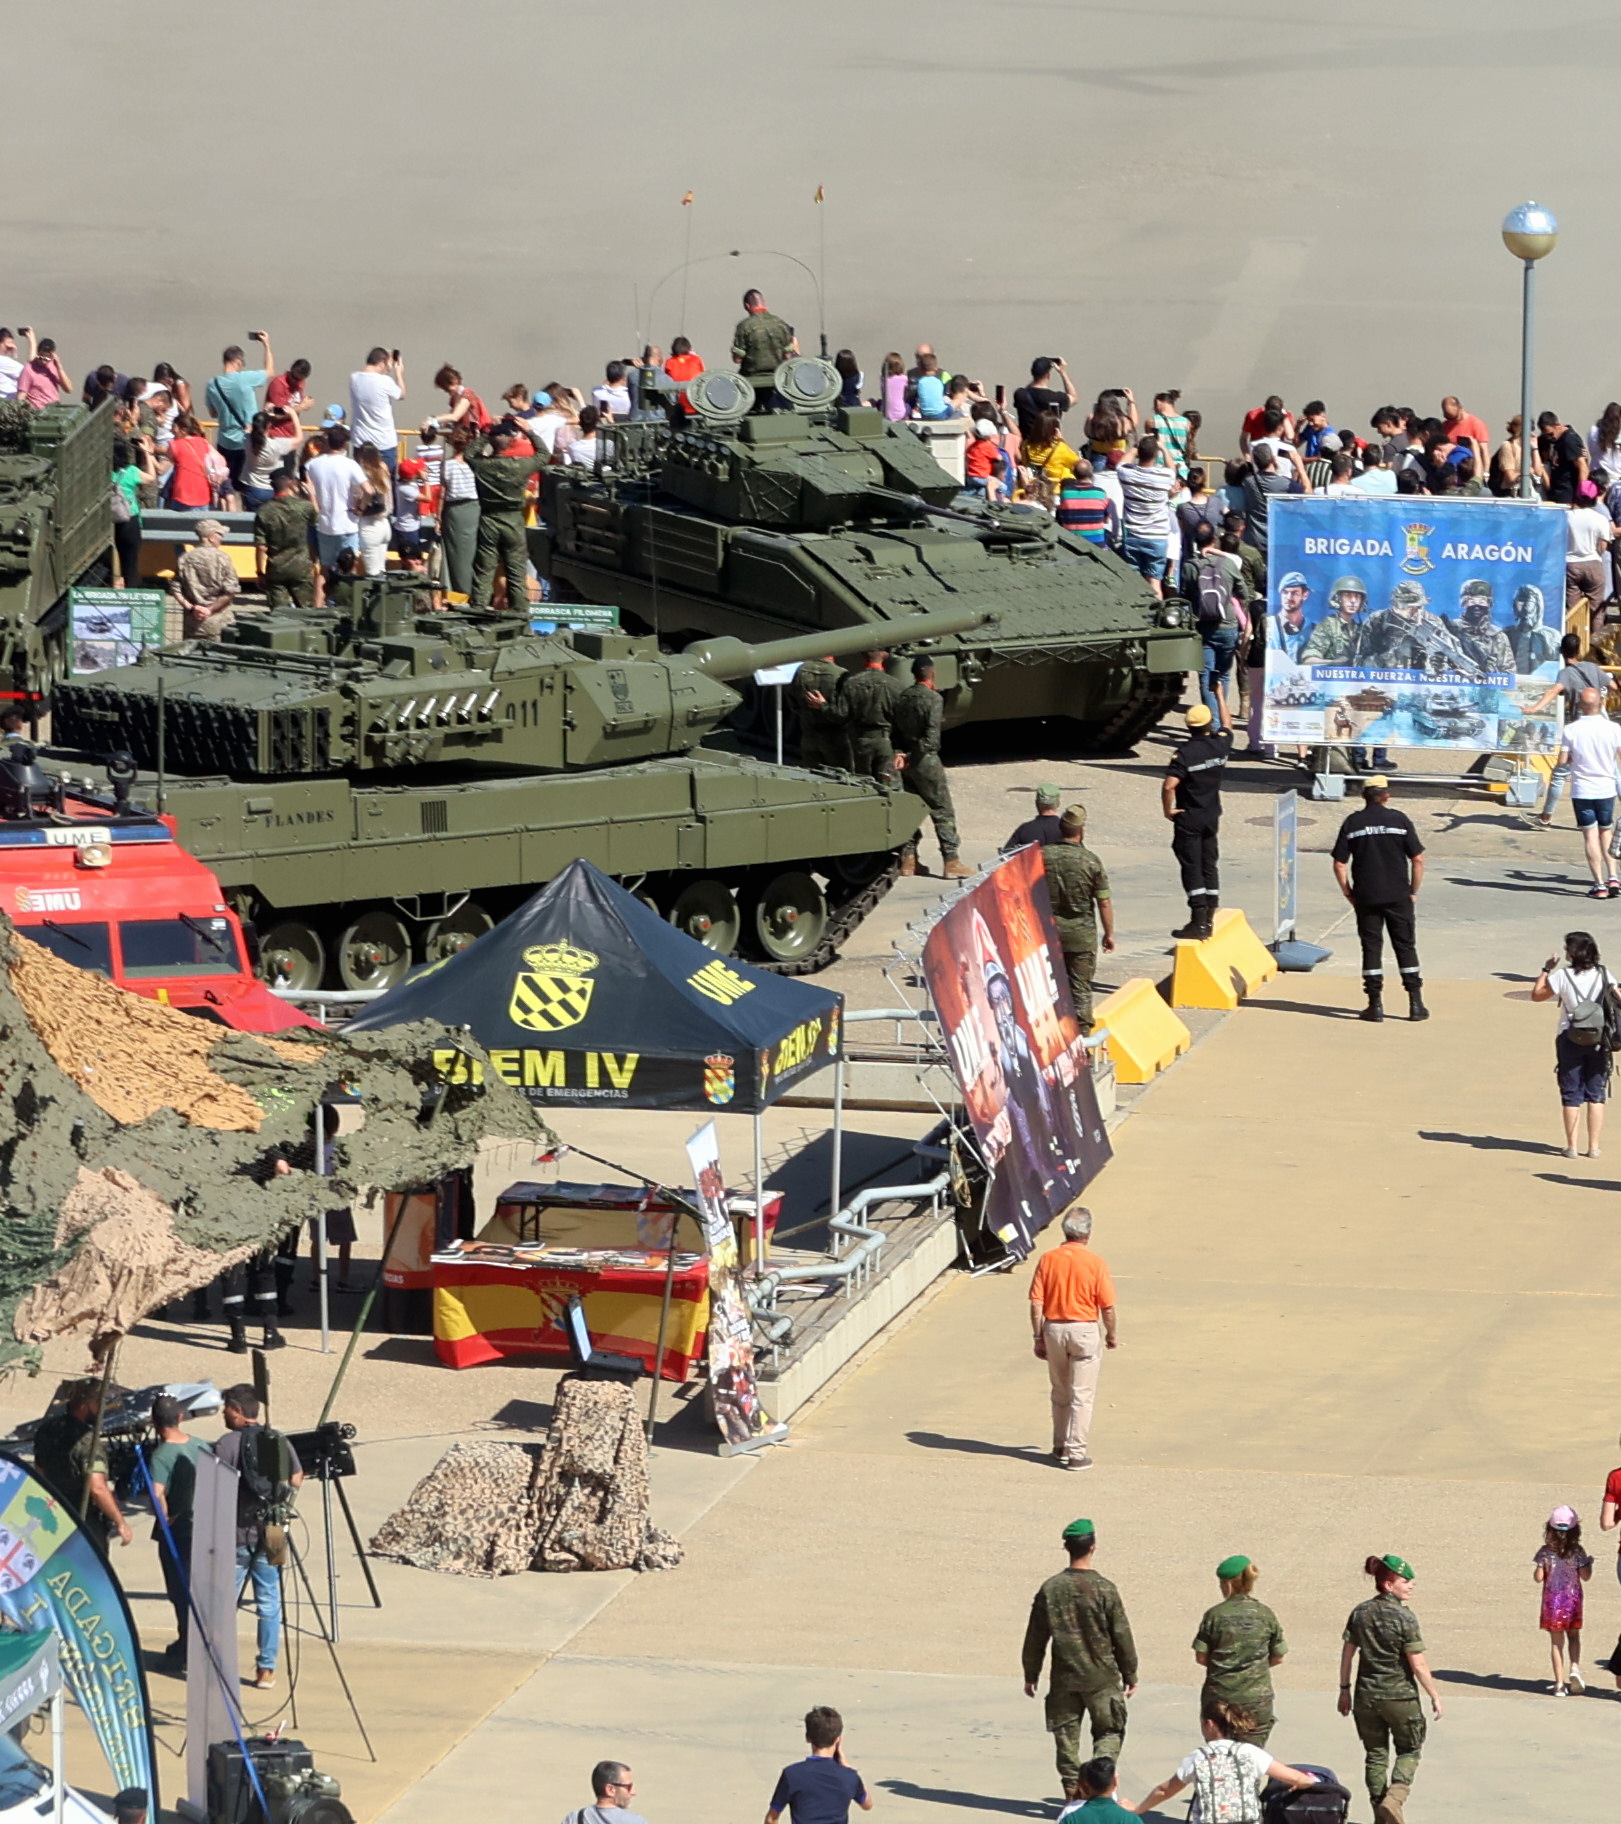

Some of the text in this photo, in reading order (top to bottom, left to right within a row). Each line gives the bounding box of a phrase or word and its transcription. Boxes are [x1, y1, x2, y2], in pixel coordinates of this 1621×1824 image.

[1304, 537, 1533, 564] BRIGADA ARAGÓN
[1316, 668, 1366, 680] NUESTRA
[1370, 670, 1416, 682] FUERZA:
[265, 809, 335, 829] FLANDES
[53, 831, 104, 845] UME
[686, 959, 757, 1006] UME
[585, 1052, 640, 1089] IV
[546, 1088, 629, 1099] EMERGENCIAS
